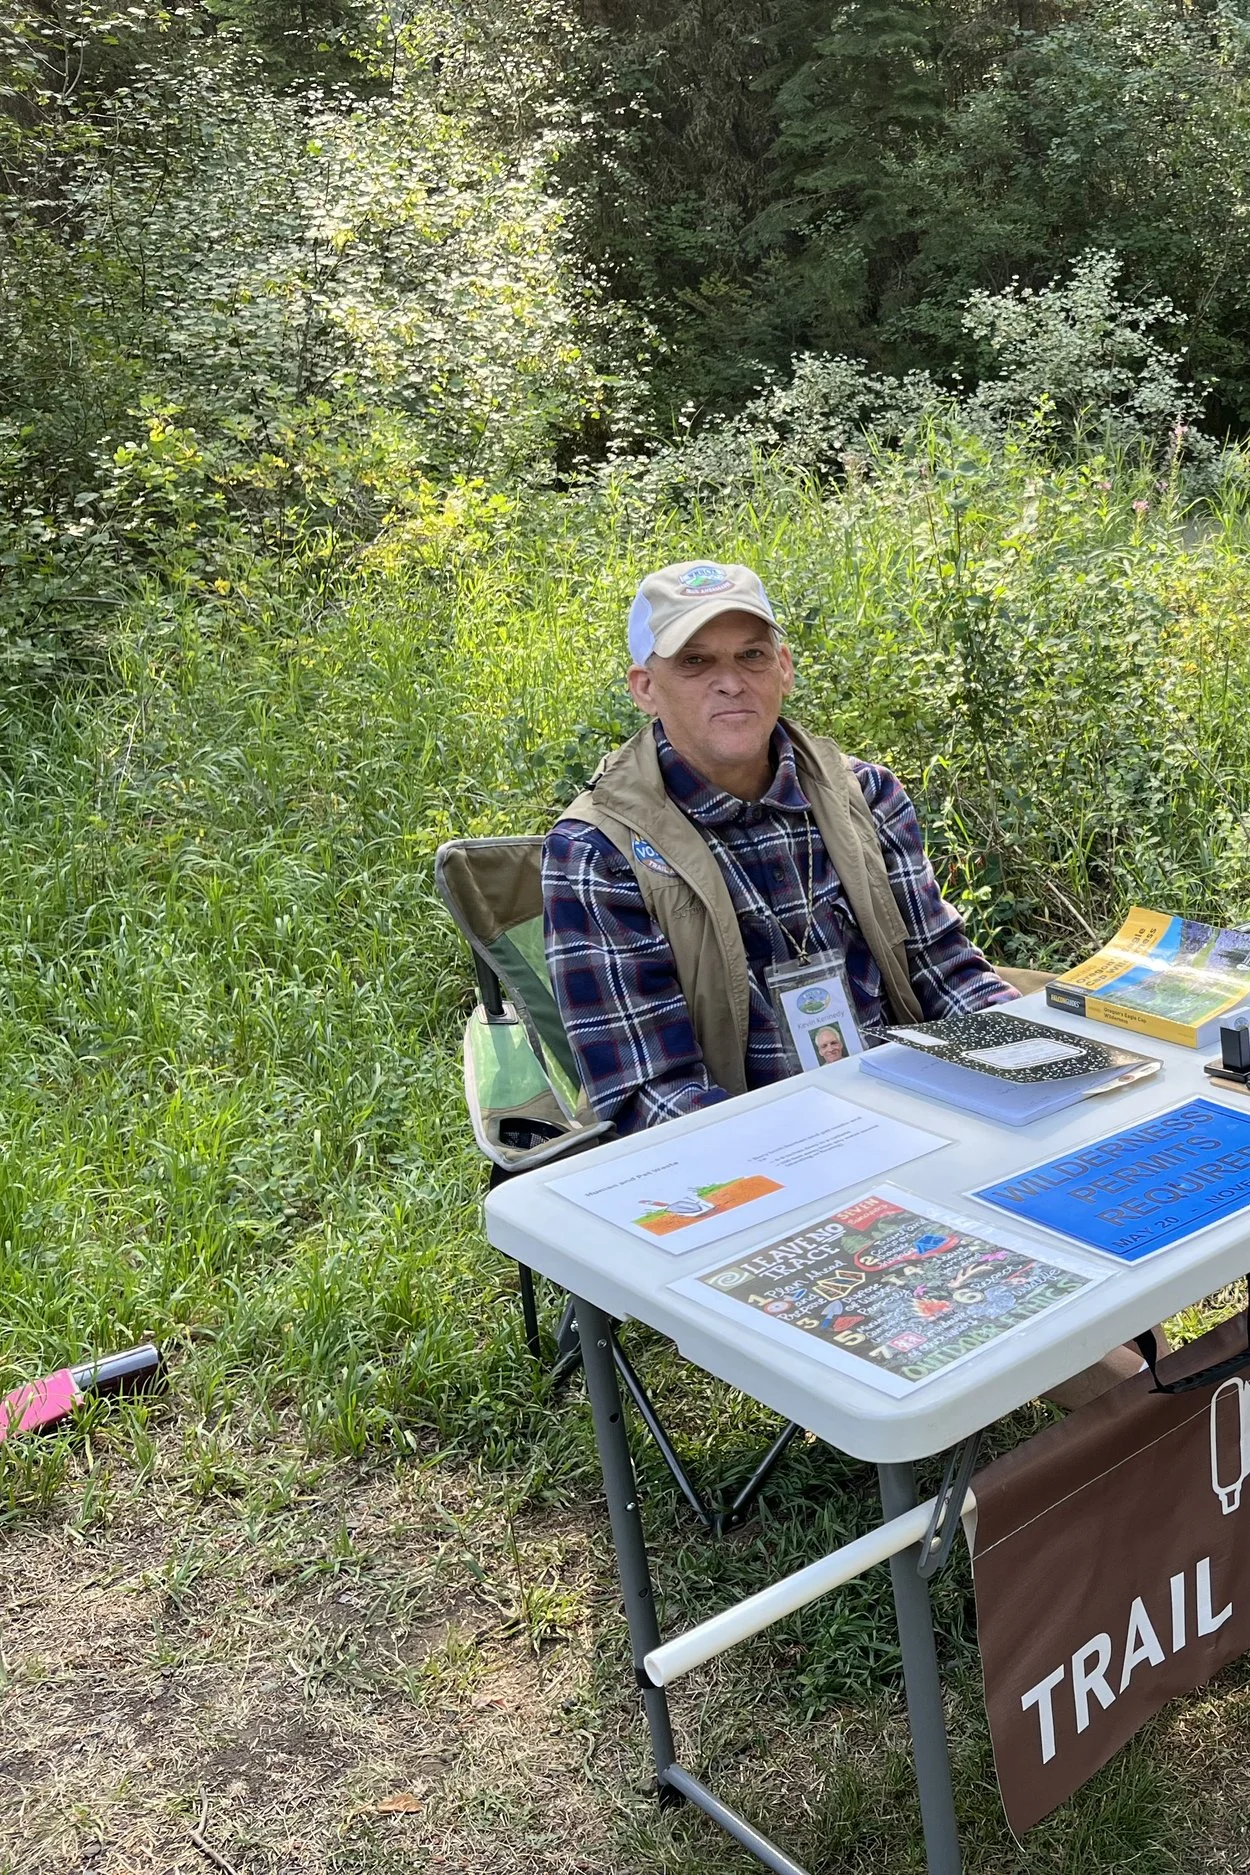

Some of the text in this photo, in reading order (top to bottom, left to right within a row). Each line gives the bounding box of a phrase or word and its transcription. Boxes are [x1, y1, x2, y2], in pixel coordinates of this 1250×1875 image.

[992, 1109, 1216, 1204] WILDERNESS
[1066, 1135, 1223, 1205] PERMITS
[836, 1198, 880, 1220] SEVEN
[740, 1222, 844, 1274] LEAVE NO
[1111, 1226, 1155, 1249] MAY
[1154, 1215, 1180, 1230] 20
[758, 1243, 840, 1281] TRACE
[859, 1254, 879, 1266] 2
[902, 1264, 924, 1277] 4
[747, 1259, 847, 1307] 1 Plan Ahead
[793, 1292, 820, 1308] and
[952, 1263, 1023, 1304] 6 Respect
[776, 1298, 828, 1322] Prepare
[795, 1282, 882, 1329] 3 Dispose
[832, 1330, 867, 1346] 5
[868, 1346, 893, 1360] 7
[901, 1323, 1003, 1379] OUTDOOR
[1021, 1556, 1233, 1765] TRAIL
